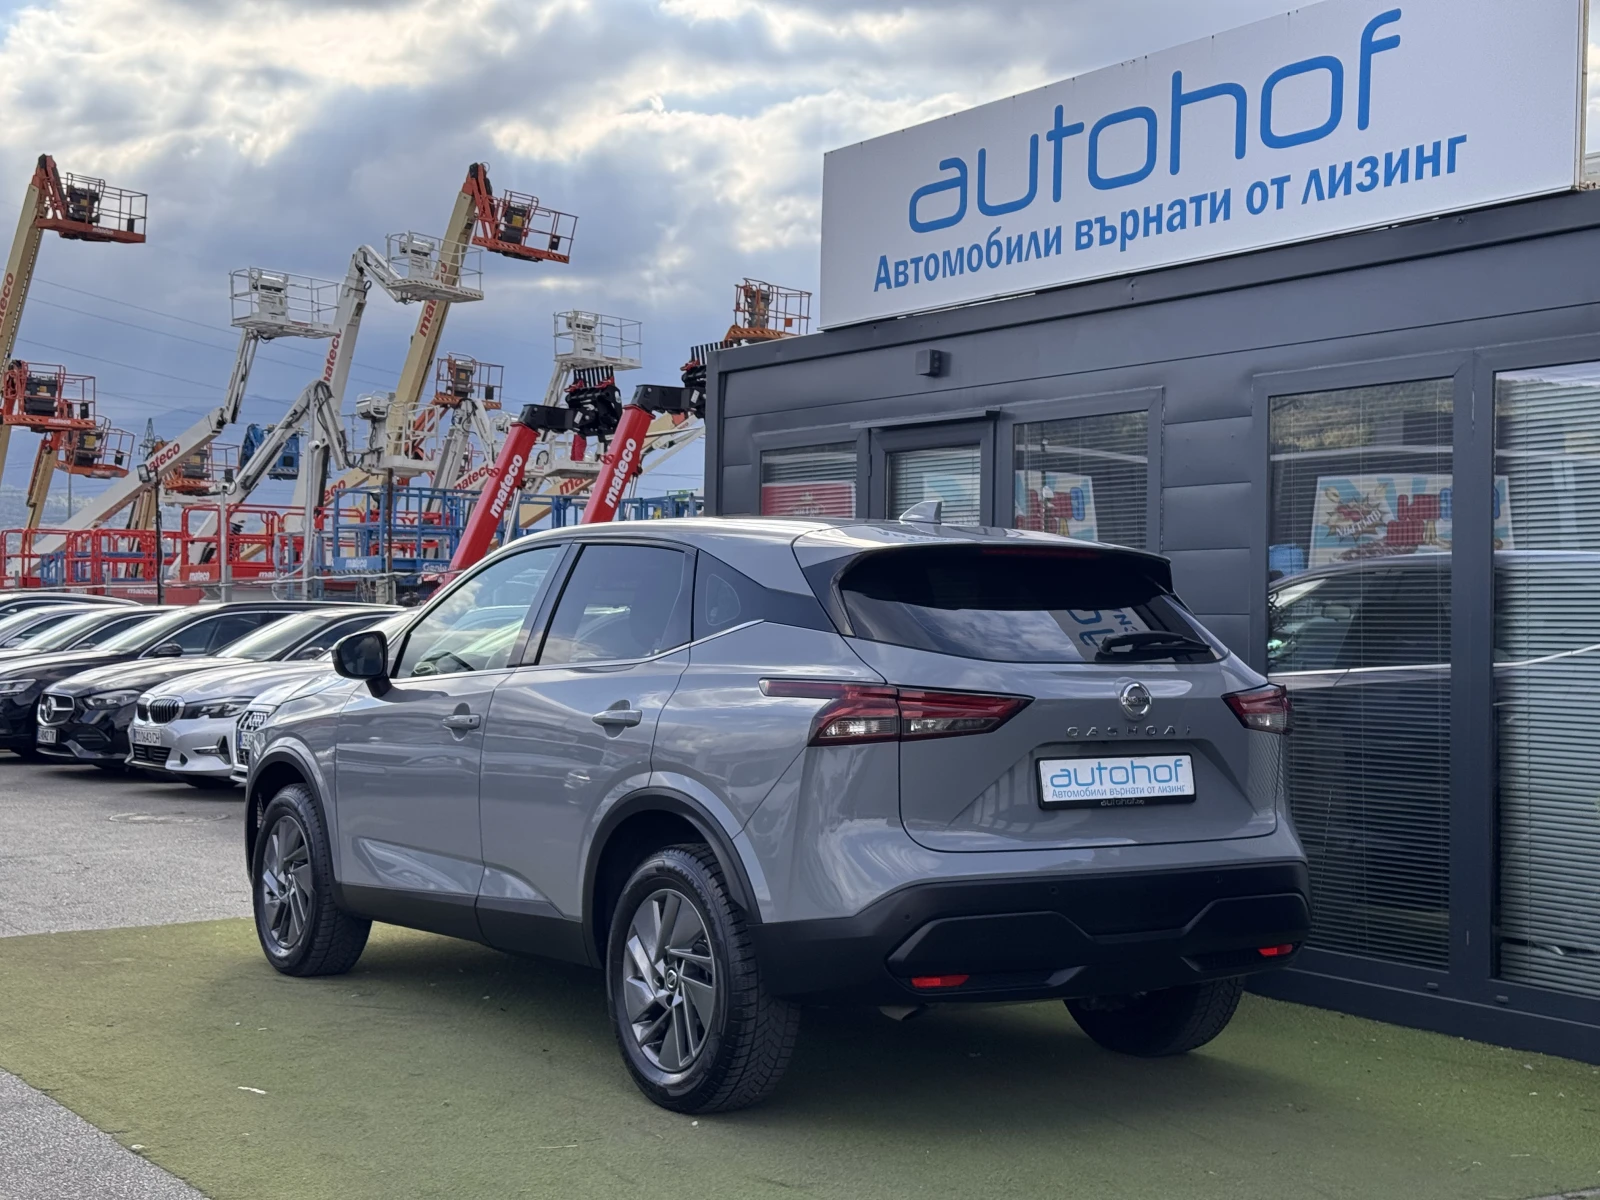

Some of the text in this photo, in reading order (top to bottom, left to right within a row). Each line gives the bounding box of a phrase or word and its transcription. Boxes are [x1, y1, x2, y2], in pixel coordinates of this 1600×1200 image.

[909, 8, 1401, 233] autohof
[873, 134, 1467, 292] Автомобили върнати от лизинг
[149, 443, 180, 472] ateco
[604, 438, 637, 508] mateco
[490, 454, 523, 518] mateco
[1066, 725, 1192, 737] QASHQAI
[1050, 759, 1183, 788] autohof
[1052, 784, 1185, 798] Автомобили върнати от лизинг
